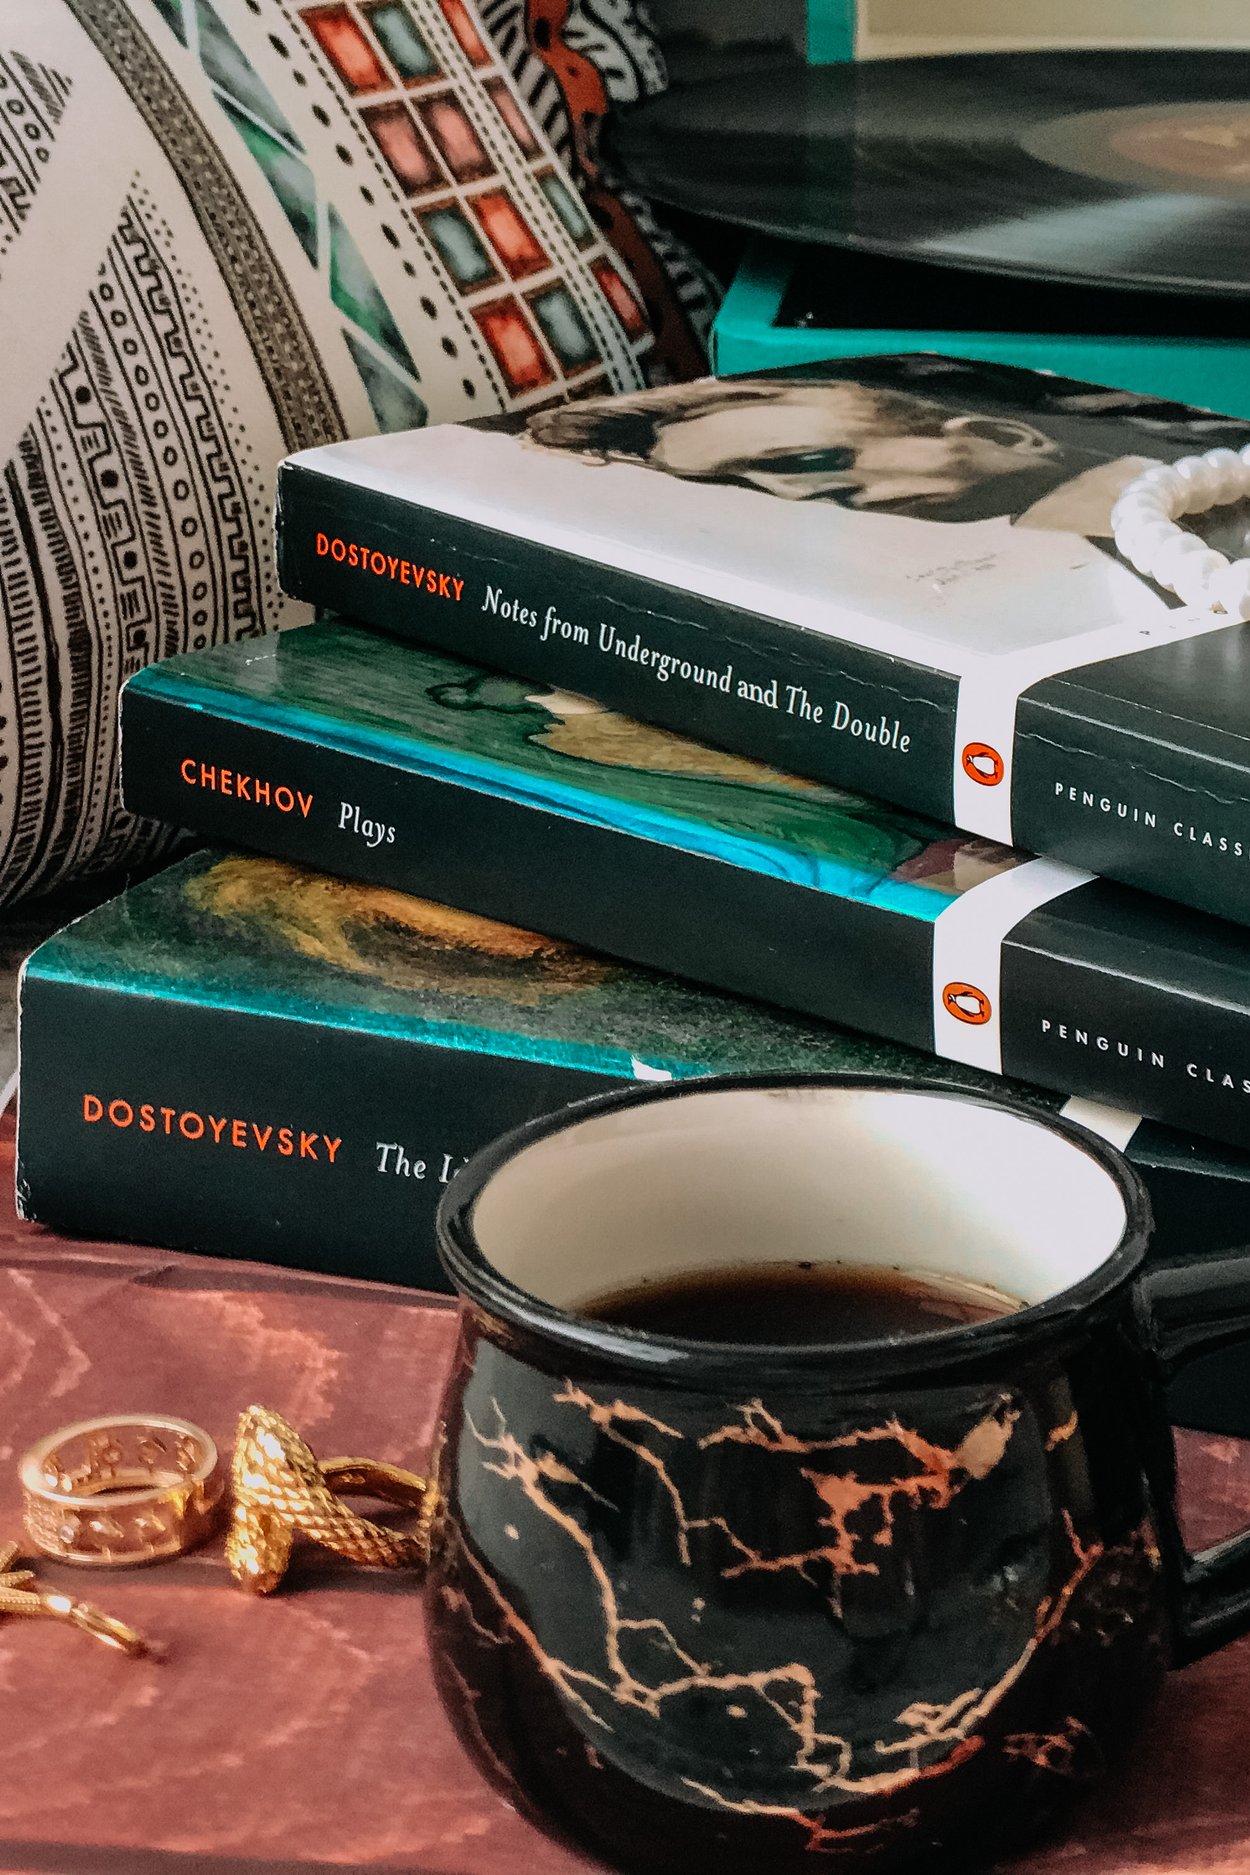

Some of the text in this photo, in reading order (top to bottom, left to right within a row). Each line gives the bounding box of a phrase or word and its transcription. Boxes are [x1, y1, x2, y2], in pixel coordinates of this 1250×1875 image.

[316, 532, 912, 754] DOSTOYEVSKY Notes from Underground and The Double
[180, 758, 396, 848] CHEKHOV Plays
[1055, 782, 1157, 828] PENGUIN
[1041, 1018, 1165, 1069] PENGUIN
[83, 1093, 342, 1164] DOSTOYEVSKY
[375, 1141, 427, 1180] The
